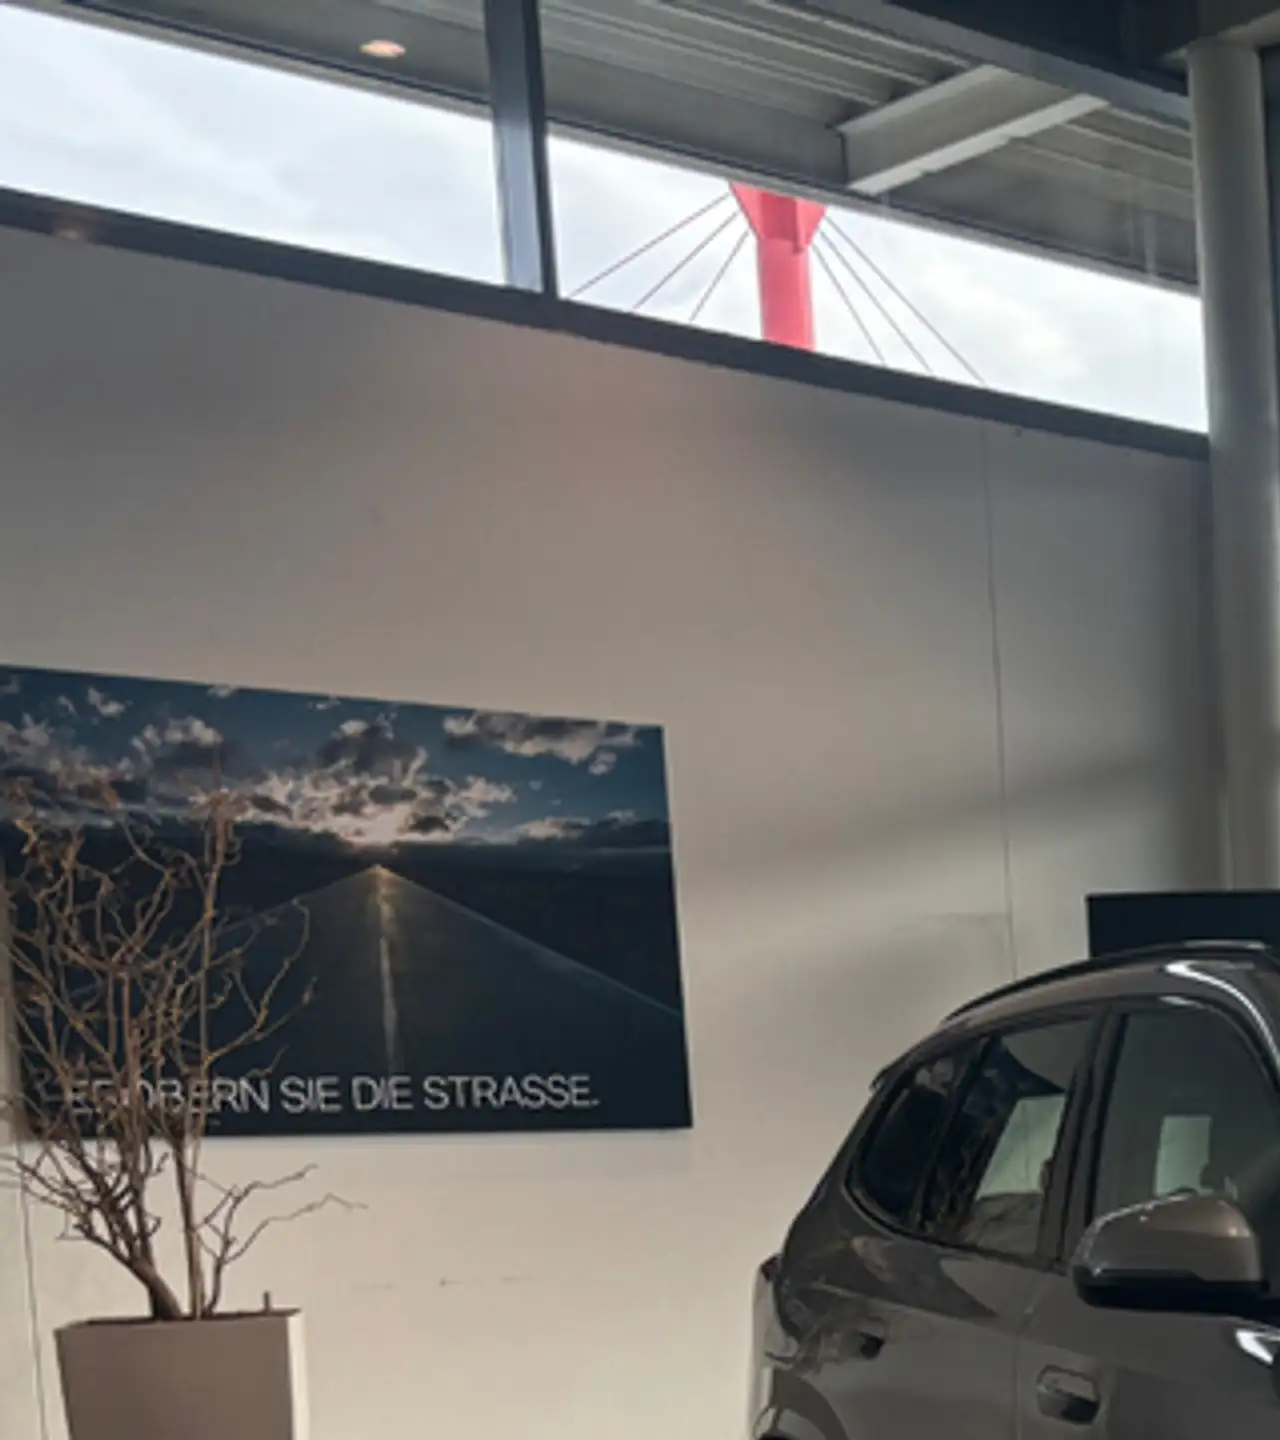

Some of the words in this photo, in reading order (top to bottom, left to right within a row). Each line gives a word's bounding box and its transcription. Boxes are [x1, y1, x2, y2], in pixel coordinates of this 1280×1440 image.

[279, 1075, 343, 1114] SIE
[351, 1075, 415, 1112] DIE
[422, 1073, 601, 1110] STRASSE.
